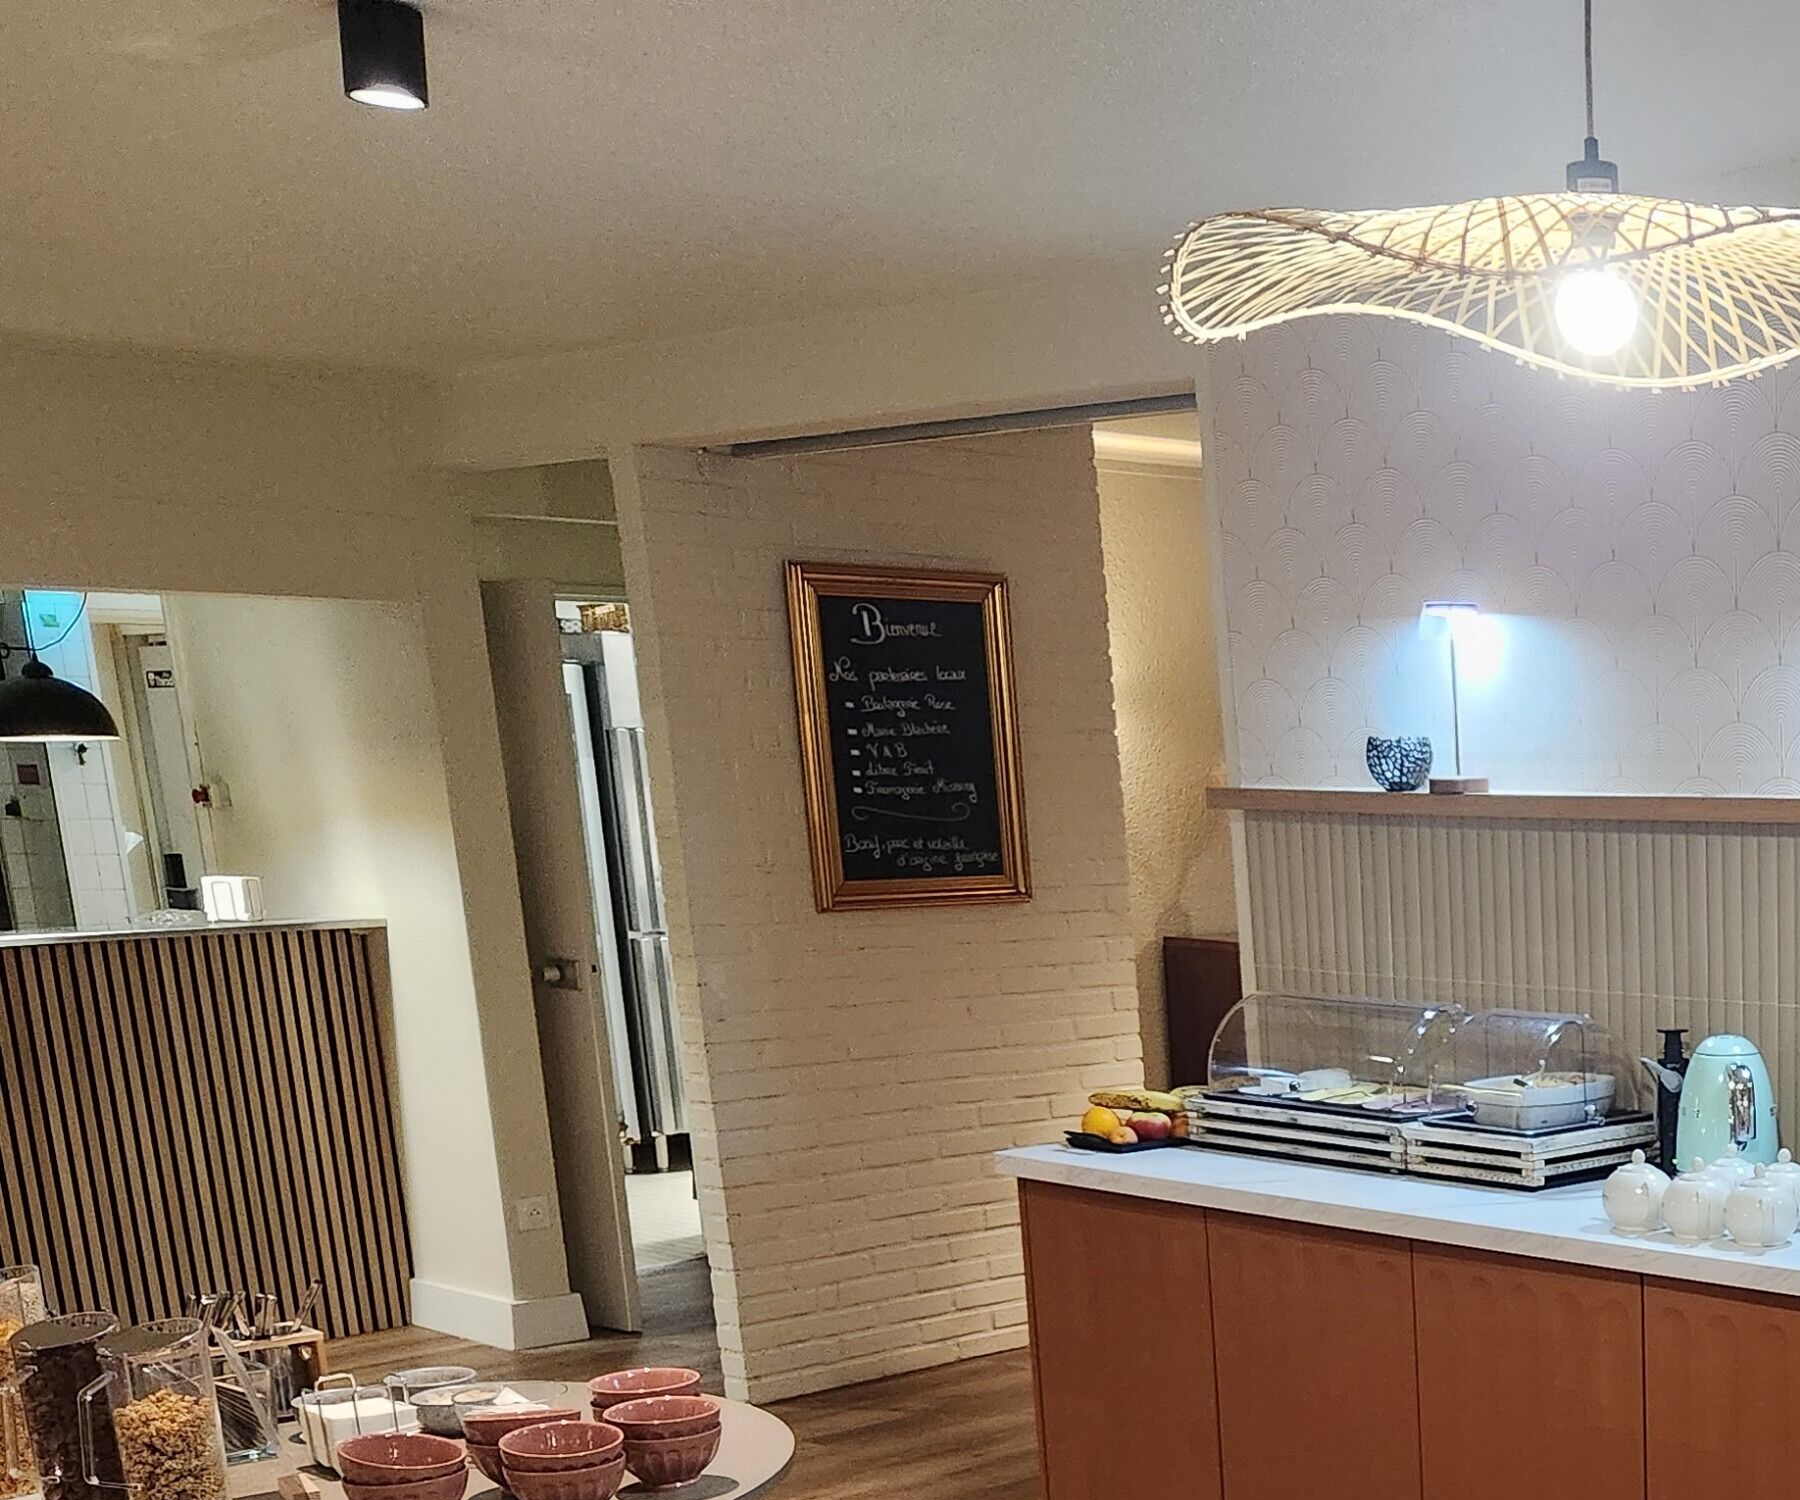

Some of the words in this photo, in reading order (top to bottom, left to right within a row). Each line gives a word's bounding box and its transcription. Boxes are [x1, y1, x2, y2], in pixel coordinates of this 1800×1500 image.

[850, 602, 943, 645] Bienvenue
[829, 656, 858, 682] Nos
[869, 666, 928, 691] partenaires
[936, 665, 967, 681] locaux
[865, 742, 879, 758] V
[895, 742, 907, 758] B
[913, 837, 924, 849] et
[926, 836, 969, 850] volaille
